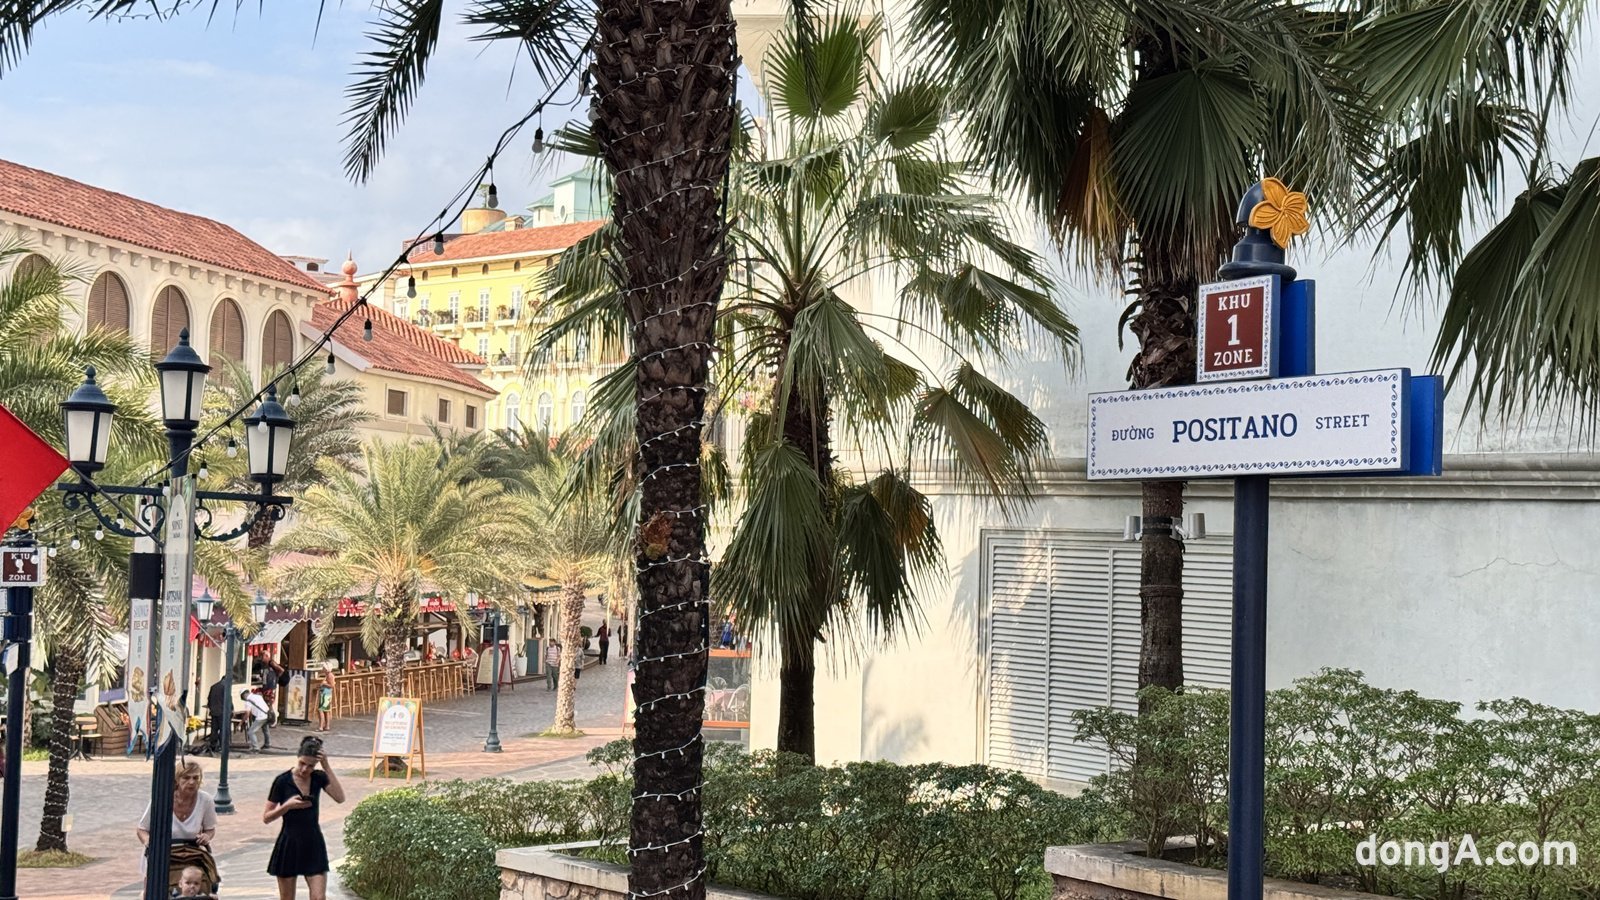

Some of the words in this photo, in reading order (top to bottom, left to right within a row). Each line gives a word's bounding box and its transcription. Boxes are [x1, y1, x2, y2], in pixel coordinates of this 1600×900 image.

[1218, 292, 1251, 311] KHU
[1227, 314, 1241, 347] 1
[1213, 348, 1253, 367] ZONE
[1111, 426, 1155, 441] ĐƯỜNG
[1172, 412, 1298, 443] POSITANO
[1315, 413, 1370, 430] STREET
